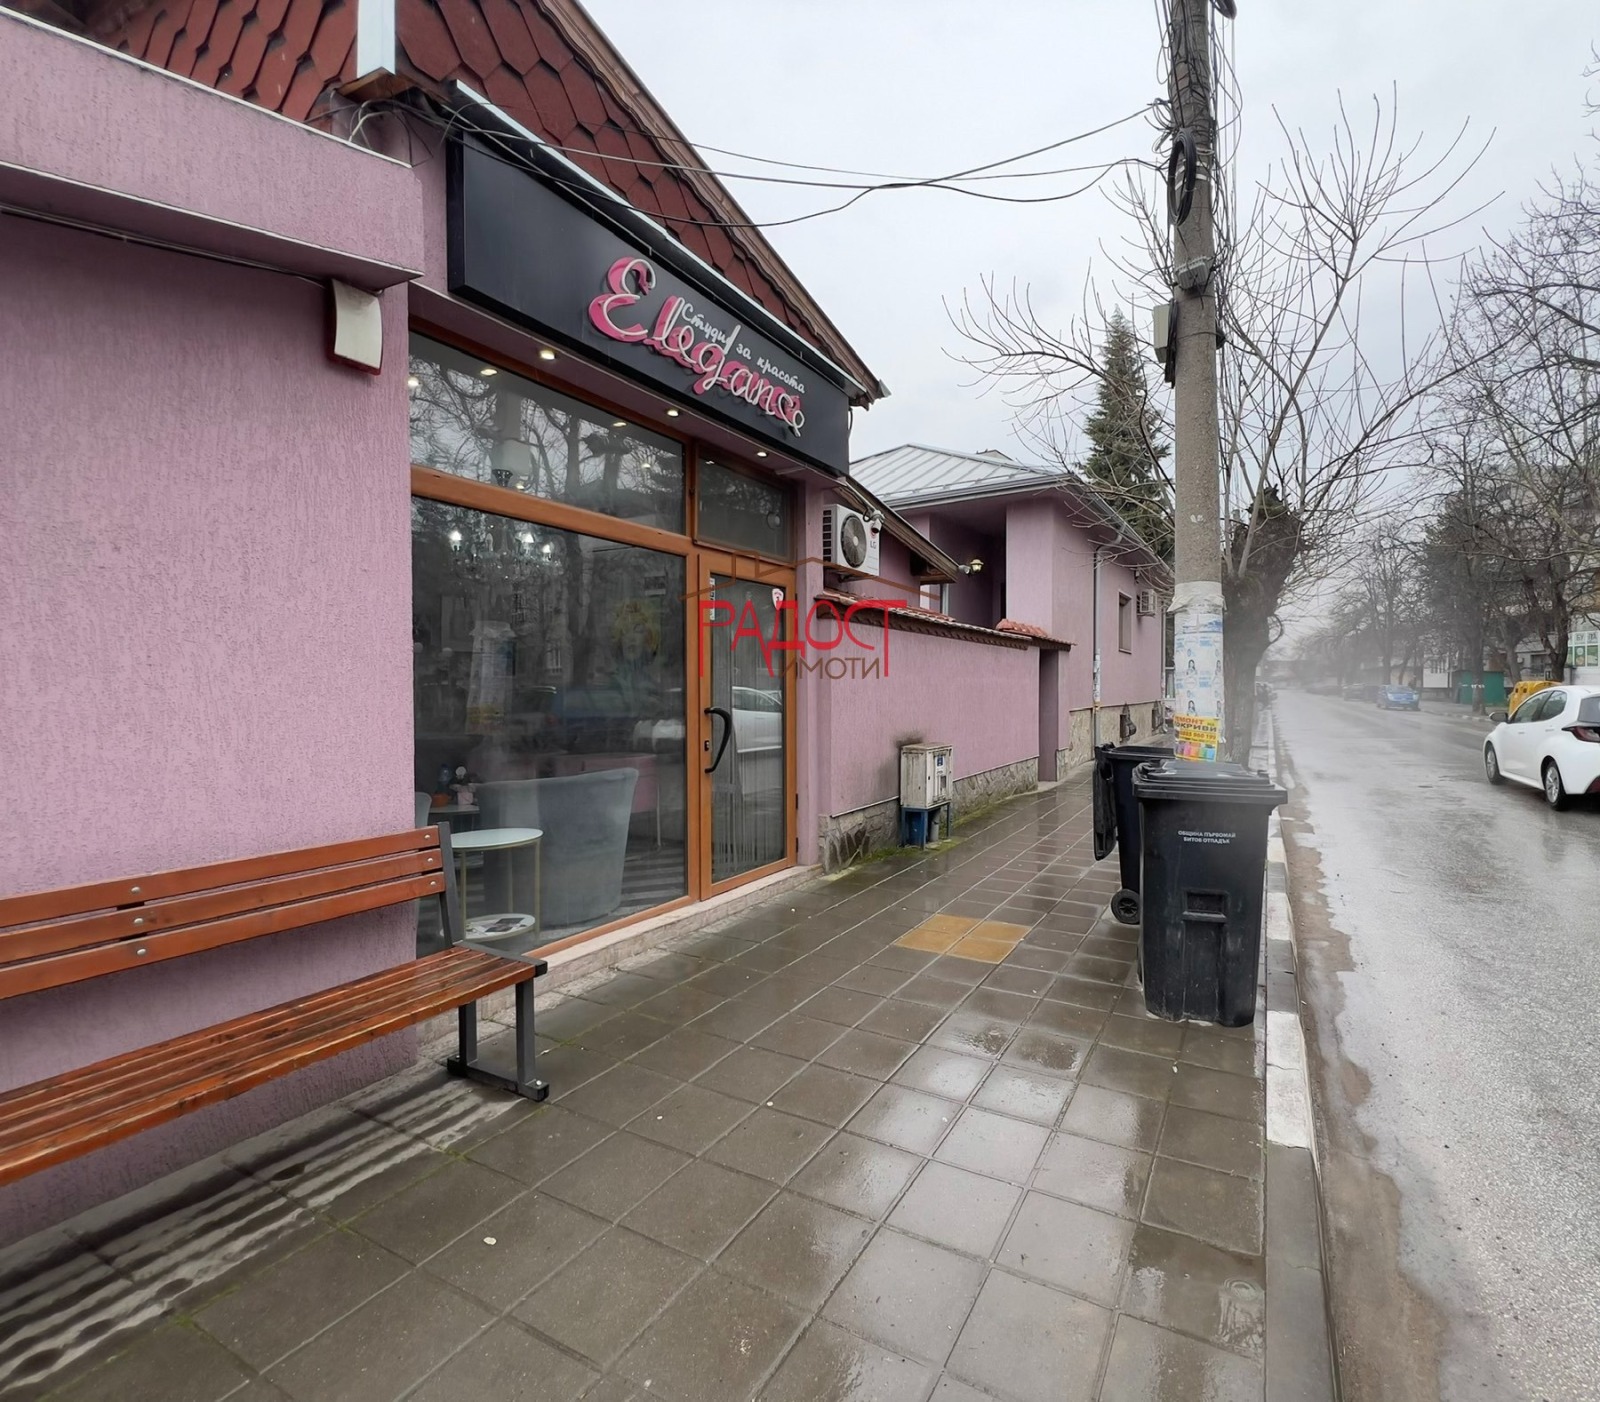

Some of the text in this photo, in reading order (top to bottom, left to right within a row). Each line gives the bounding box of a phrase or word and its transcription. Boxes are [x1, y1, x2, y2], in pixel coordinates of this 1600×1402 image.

[736, 343, 752, 360] за
[757, 356, 805, 394] красота
[870, 540, 877, 549] LG
